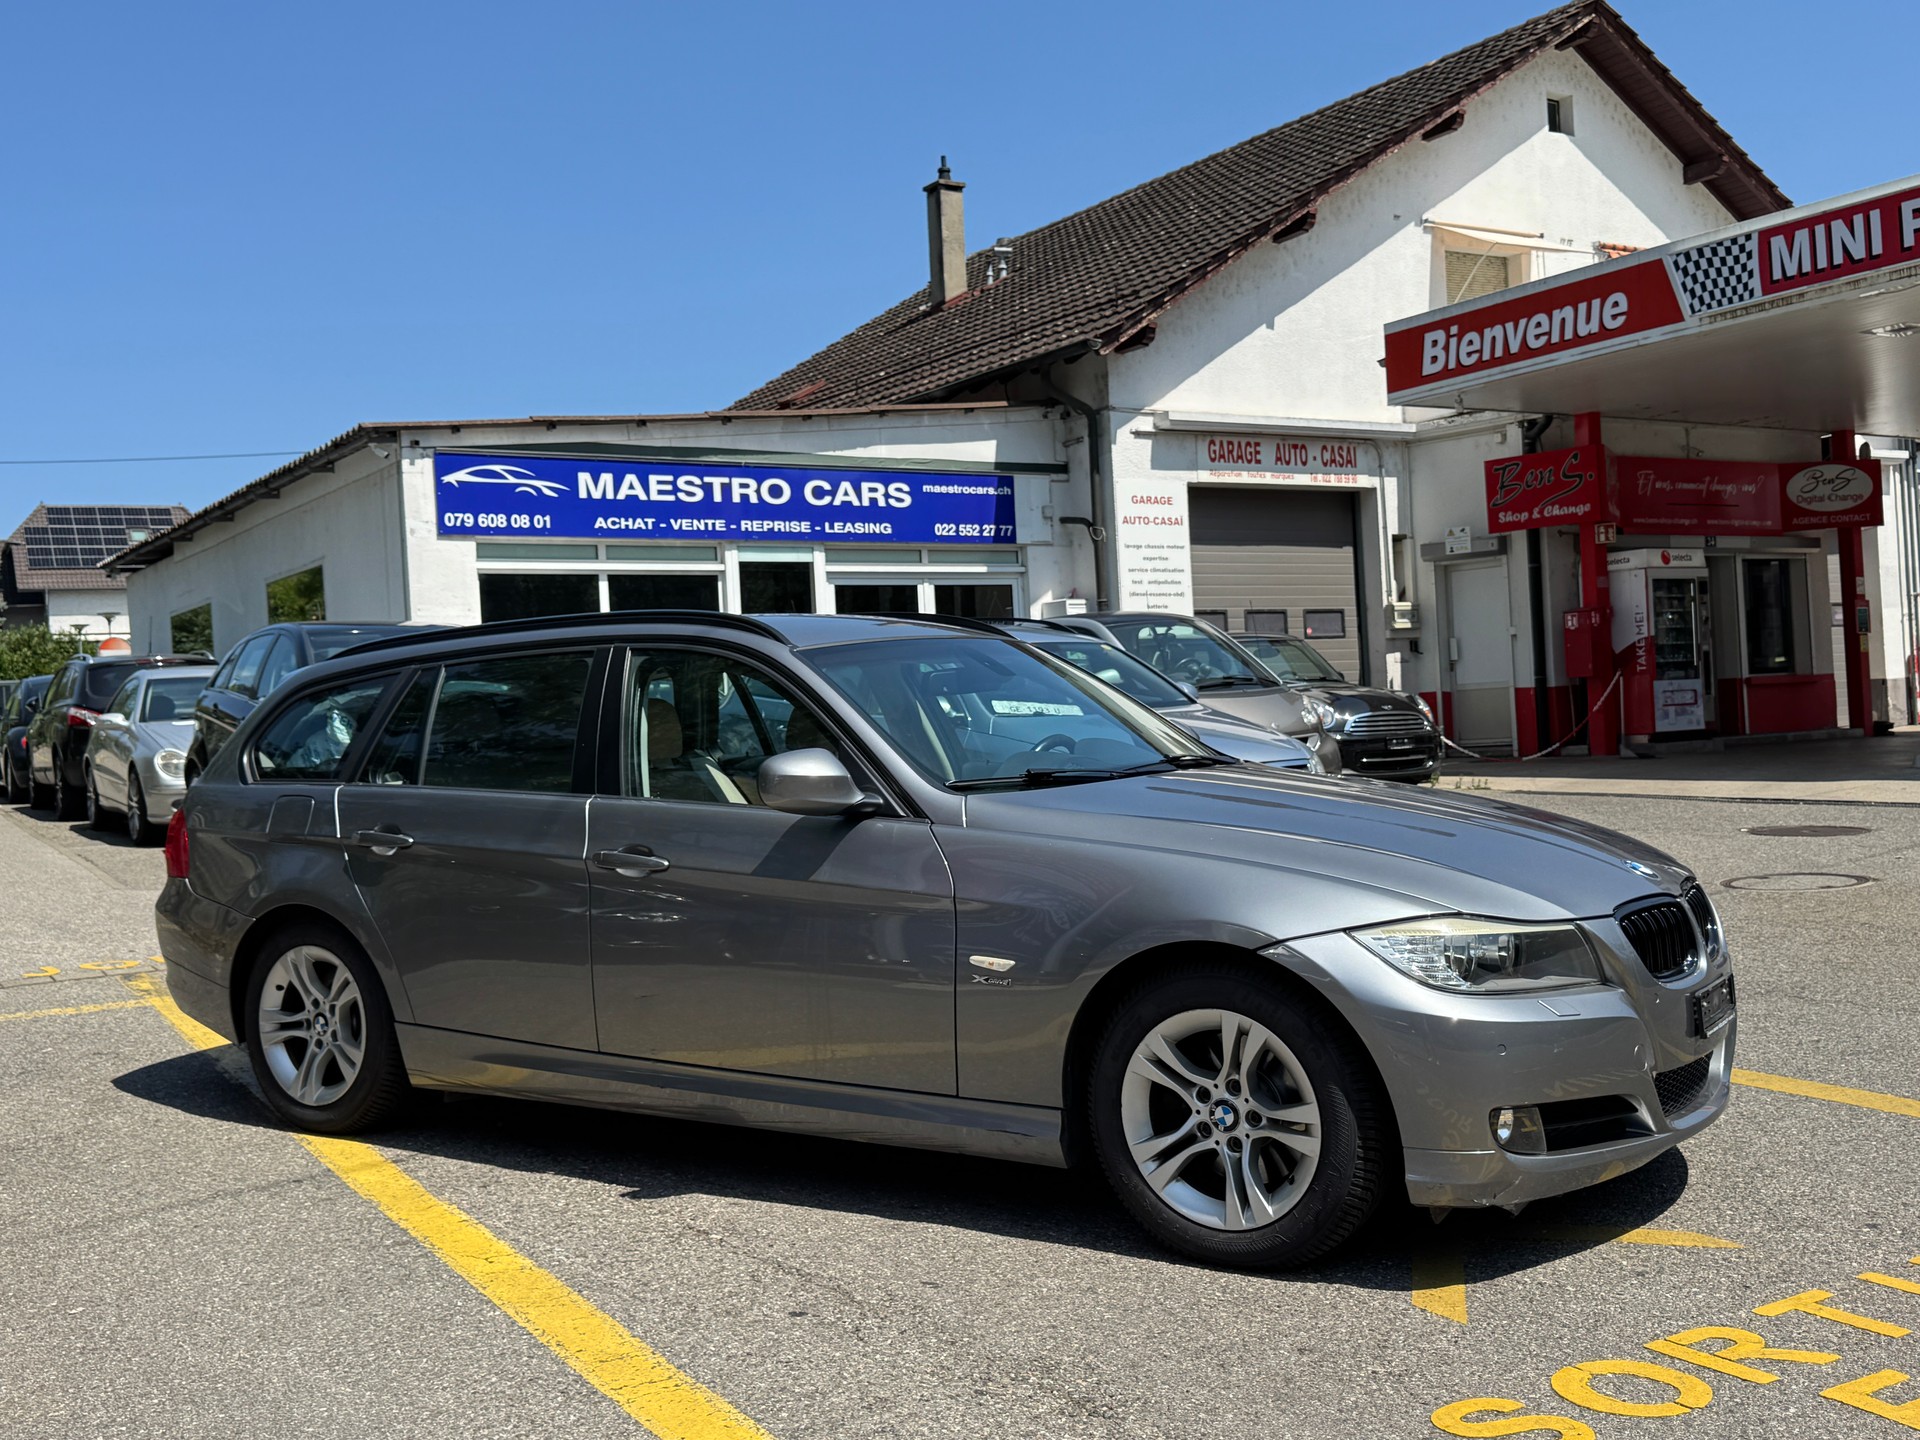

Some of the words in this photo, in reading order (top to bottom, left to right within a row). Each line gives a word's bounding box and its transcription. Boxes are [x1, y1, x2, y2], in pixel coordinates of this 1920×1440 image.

[1770, 207, 1885, 284] MINI
[1421, 291, 1629, 377] Bienvenue
[1207, 438, 1262, 465] GARAGE
[1274, 442, 1308, 467] AUTO
[577, 471, 792, 505] MAESTRO
[803, 479, 913, 508] CARS
[922, 484, 1012, 496] maestrocars.ch
[1490, 461, 1555, 508] Ben
[1131, 495, 1174, 506] GARAGE
[1796, 493, 1826, 505] Digital
[1827, 493, 1864, 503] Change
[444, 512, 475, 528] 079
[477, 513, 506, 529] 608
[510, 514, 531, 529] 08
[533, 514, 551, 529] 01
[1498, 510, 1529, 524] Shop
[1532, 507, 1541, 519] &
[1543, 503, 1592, 517] Change
[1791, 515, 1829, 525] AGENCE
[1830, 512, 1871, 523] CONTACT
[594, 516, 656, 529] ACHAT
[670, 519, 727, 531] VENTE
[740, 520, 812, 533] REPRISE
[825, 521, 892, 534] LEASING
[934, 523, 957, 536] 022
[958, 524, 981, 537] 552
[982, 524, 997, 537] 27
[998, 525, 1014, 538] 77
[1671, 553, 1693, 562] selecta
[1636, 637, 1647, 672] TAKE
[1430, 1256, 1920, 1440] SORTI
